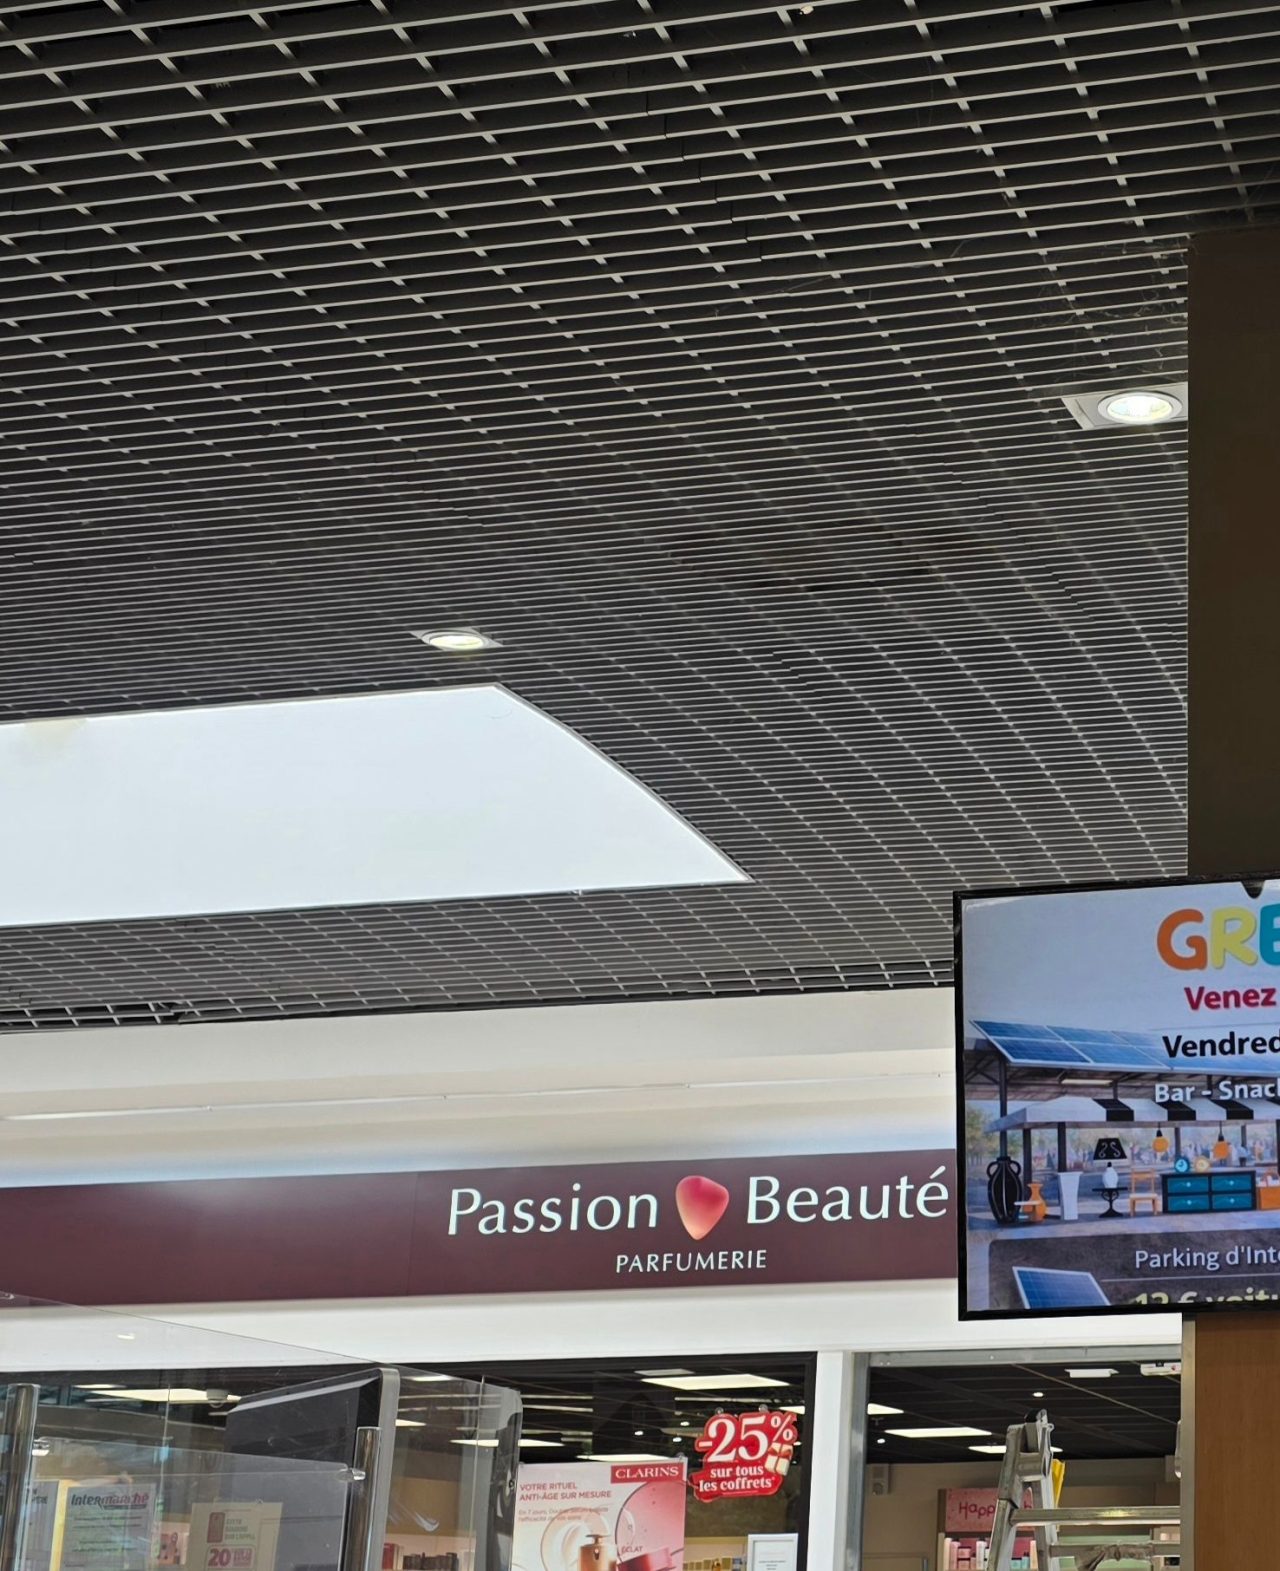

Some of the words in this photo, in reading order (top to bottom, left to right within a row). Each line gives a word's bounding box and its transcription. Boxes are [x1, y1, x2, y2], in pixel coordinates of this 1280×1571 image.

[1184, 986, 1277, 1011] Venez
[1154, 1083, 1195, 1103] Bar
[447, 1183, 659, 1236] Passion
[746, 1165, 950, 1225] Beauté
[615, 1249, 768, 1274] PARFUMERIE
[1135, 1247, 1220, 1271] Parking
[698, 1414, 793, 1463] -25%
[615, 1465, 680, 1479] CLARINS
[710, 1467, 732, 1478] sur
[735, 1465, 764, 1477] tous
[519, 1483, 548, 1491] VOTRE
[549, 1482, 577, 1490] RITUEL
[519, 1490, 558, 1501] ANTI-ÂGE
[560, 1491, 577, 1500] SUR
[578, 1490, 612, 1499] MESURE
[699, 1480, 717, 1492] les
